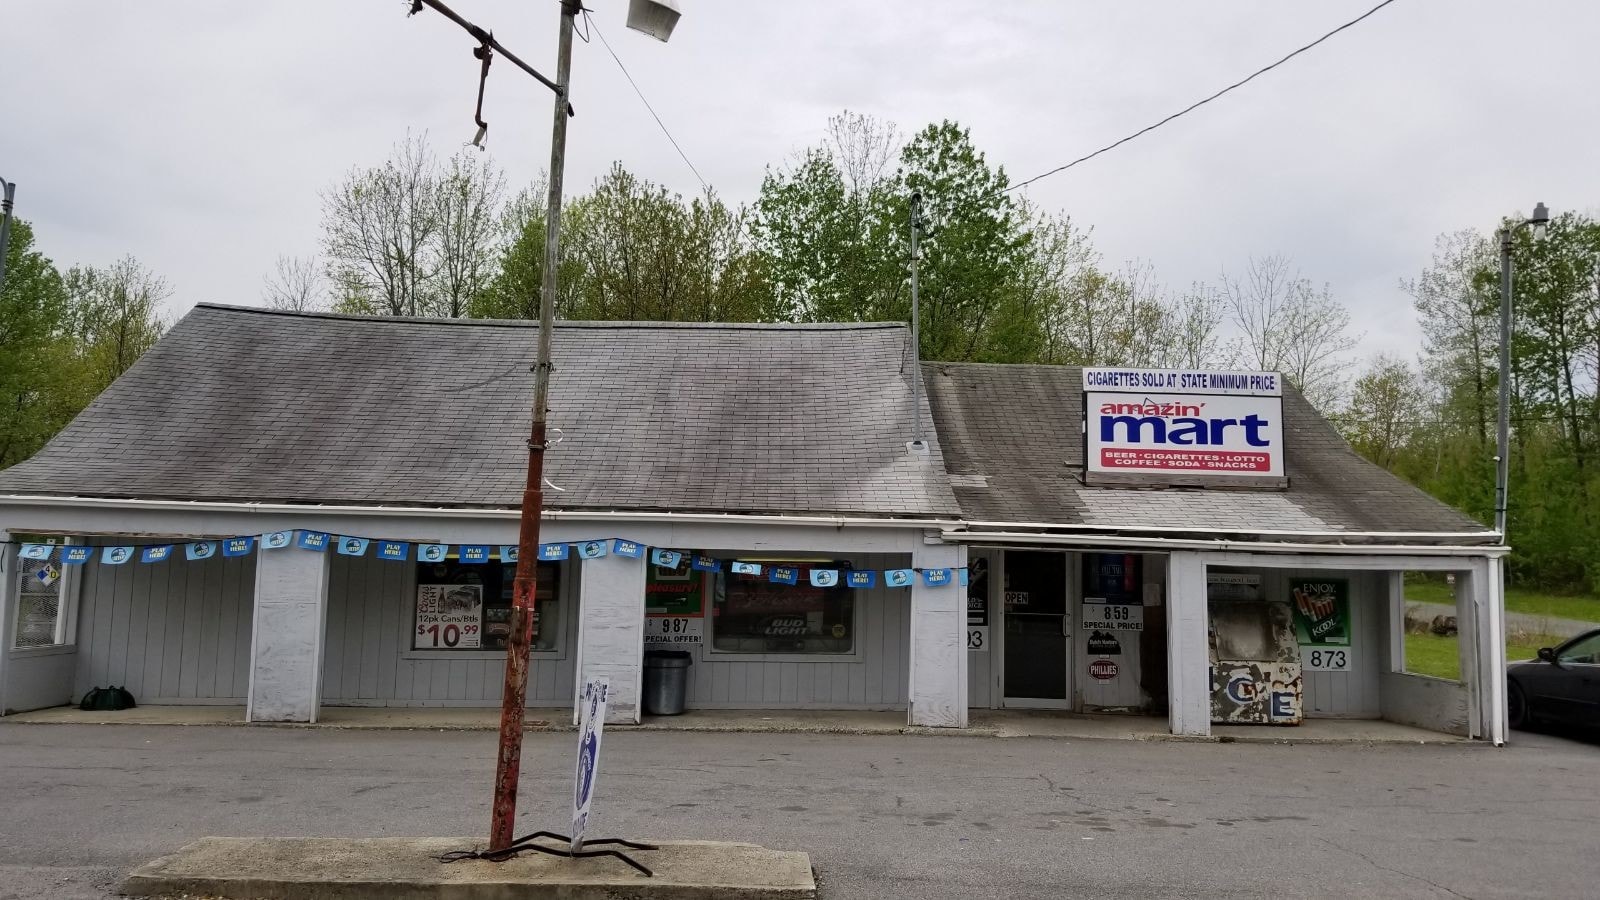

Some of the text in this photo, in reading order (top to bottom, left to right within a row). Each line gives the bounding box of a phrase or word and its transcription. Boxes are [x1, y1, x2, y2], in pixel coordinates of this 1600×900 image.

[1087, 372, 1275, 391] CIGARETTES SOLD AT STATE MINIMUM PRICE
[1100, 402, 1207, 416] amazin'
[1100, 414, 1270, 447] mart
[1144, 453, 1220, 461] CIGARETTES
[1207, 461, 1256, 469] SNACKS
[429, 586, 437, 613] LIGHT
[1005, 592, 1028, 604] OPEN
[418, 614, 479, 623] 12pk Cans/Btls
[771, 619, 804, 627] BUD
[1083, 621, 1143, 630] SPECIAL PRICE!
[1312, 618, 1337, 636] KOOL
[765, 627, 808, 635] LIGHT
[674, 635, 702, 643] OFFER!
[1310, 650, 1347, 669] 8.73
[1090, 665, 1116, 675] PHILLIES
